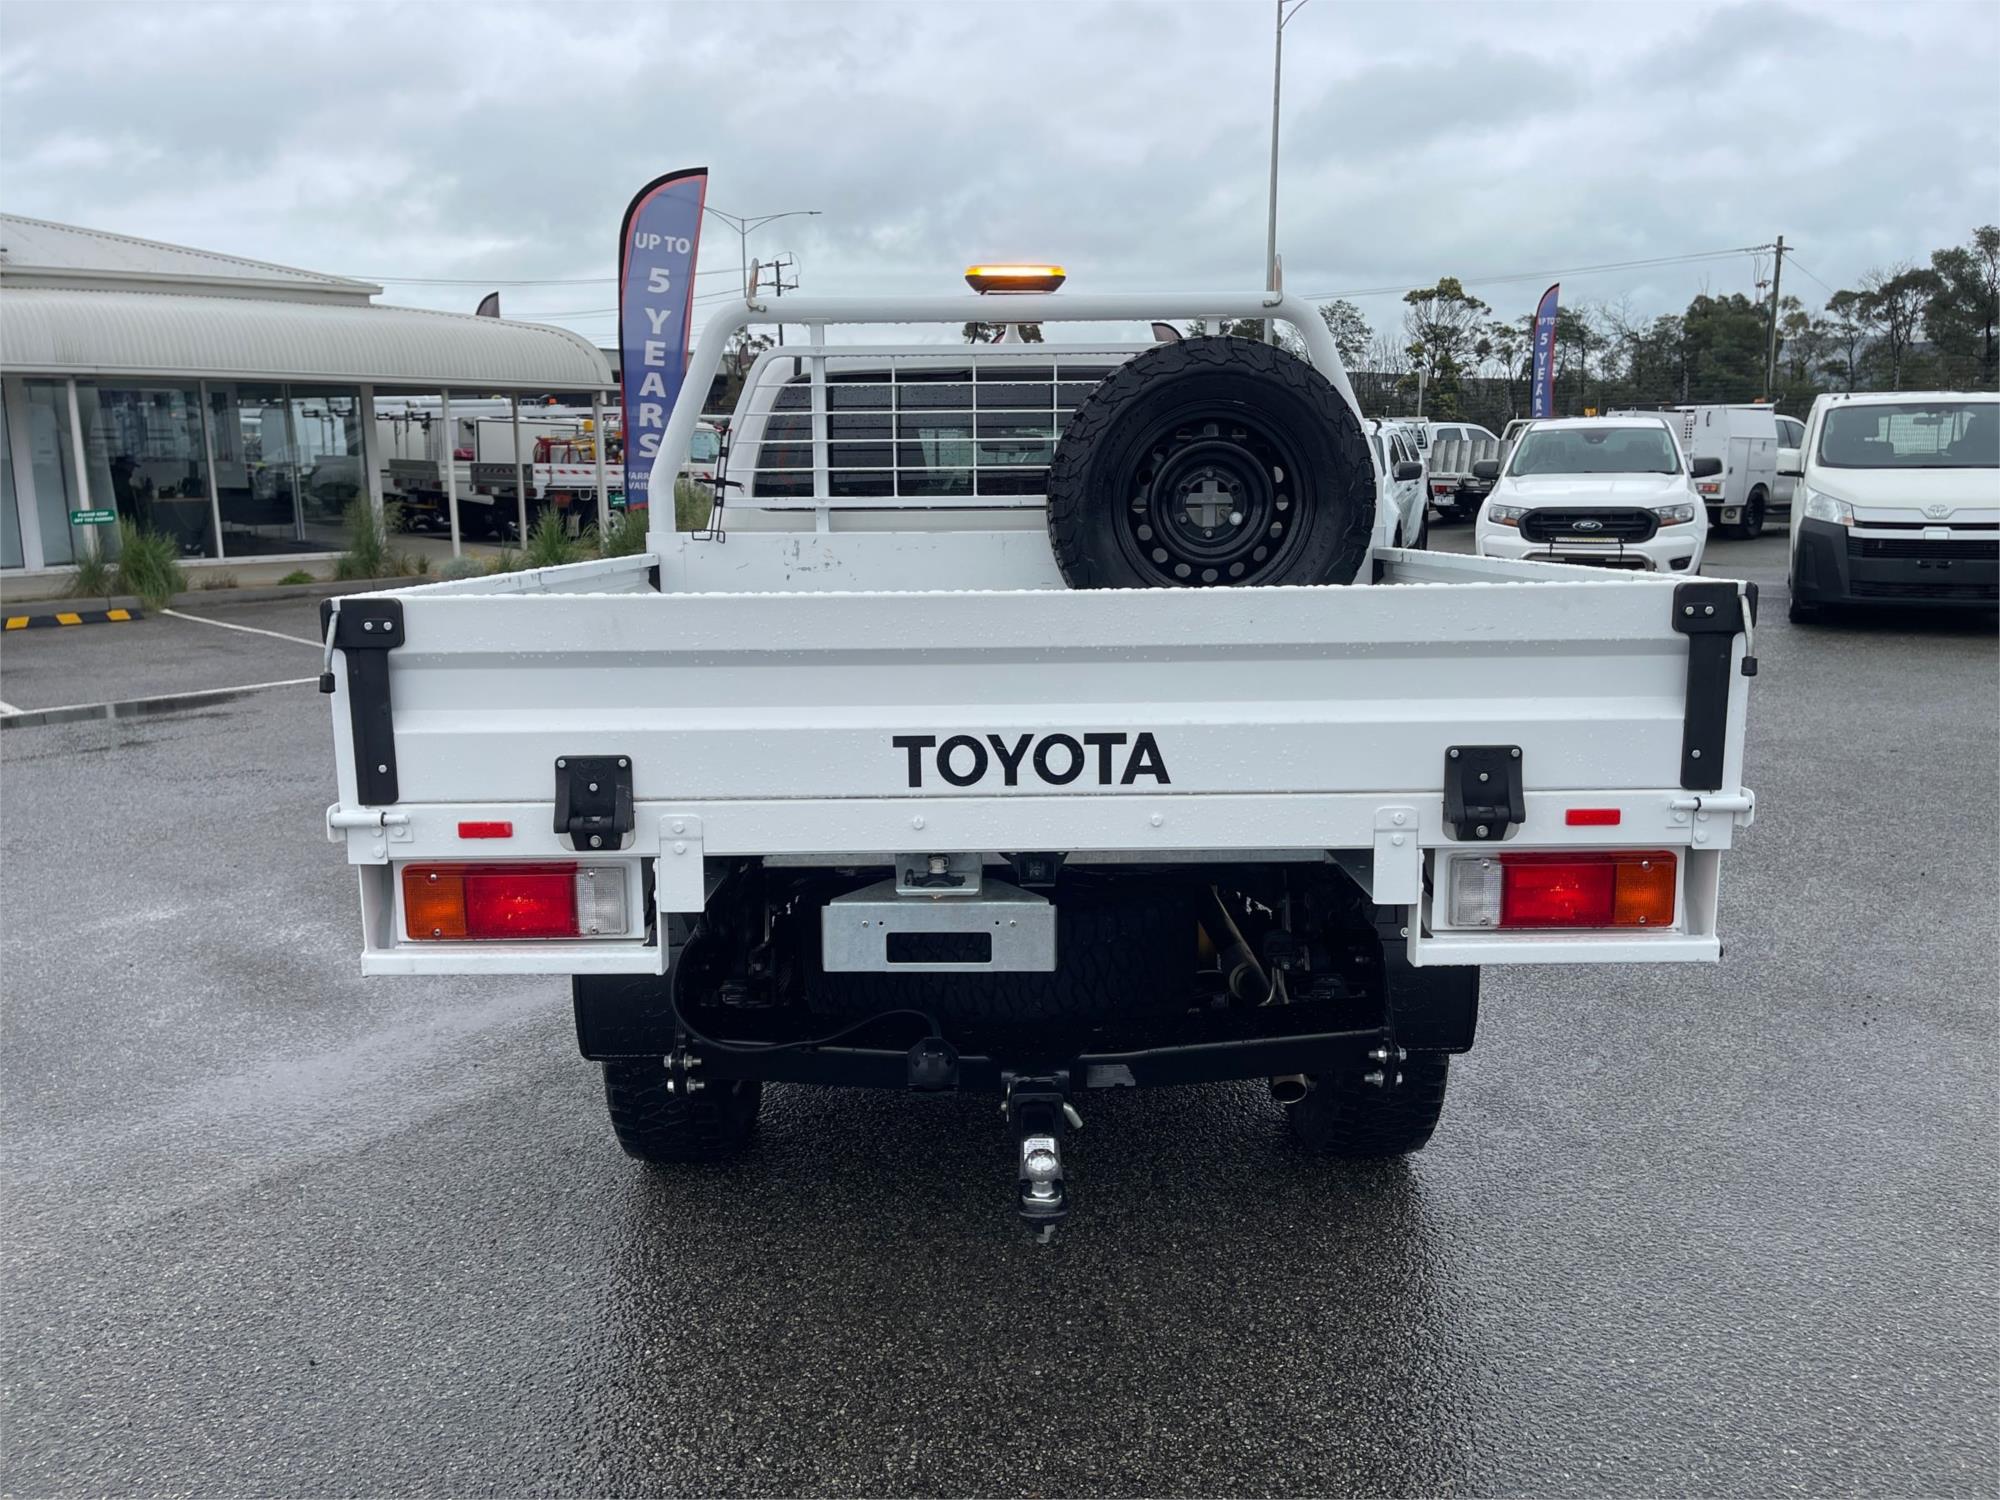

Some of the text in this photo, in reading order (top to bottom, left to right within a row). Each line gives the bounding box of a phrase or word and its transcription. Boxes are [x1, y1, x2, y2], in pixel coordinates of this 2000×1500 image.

[635, 232, 691, 254] UP TO
[647, 267, 670, 293] 5
[1540, 333, 1549, 346] 5
[638, 307, 671, 458] YEARS
[892, 732, 1172, 788] TOYOTA
